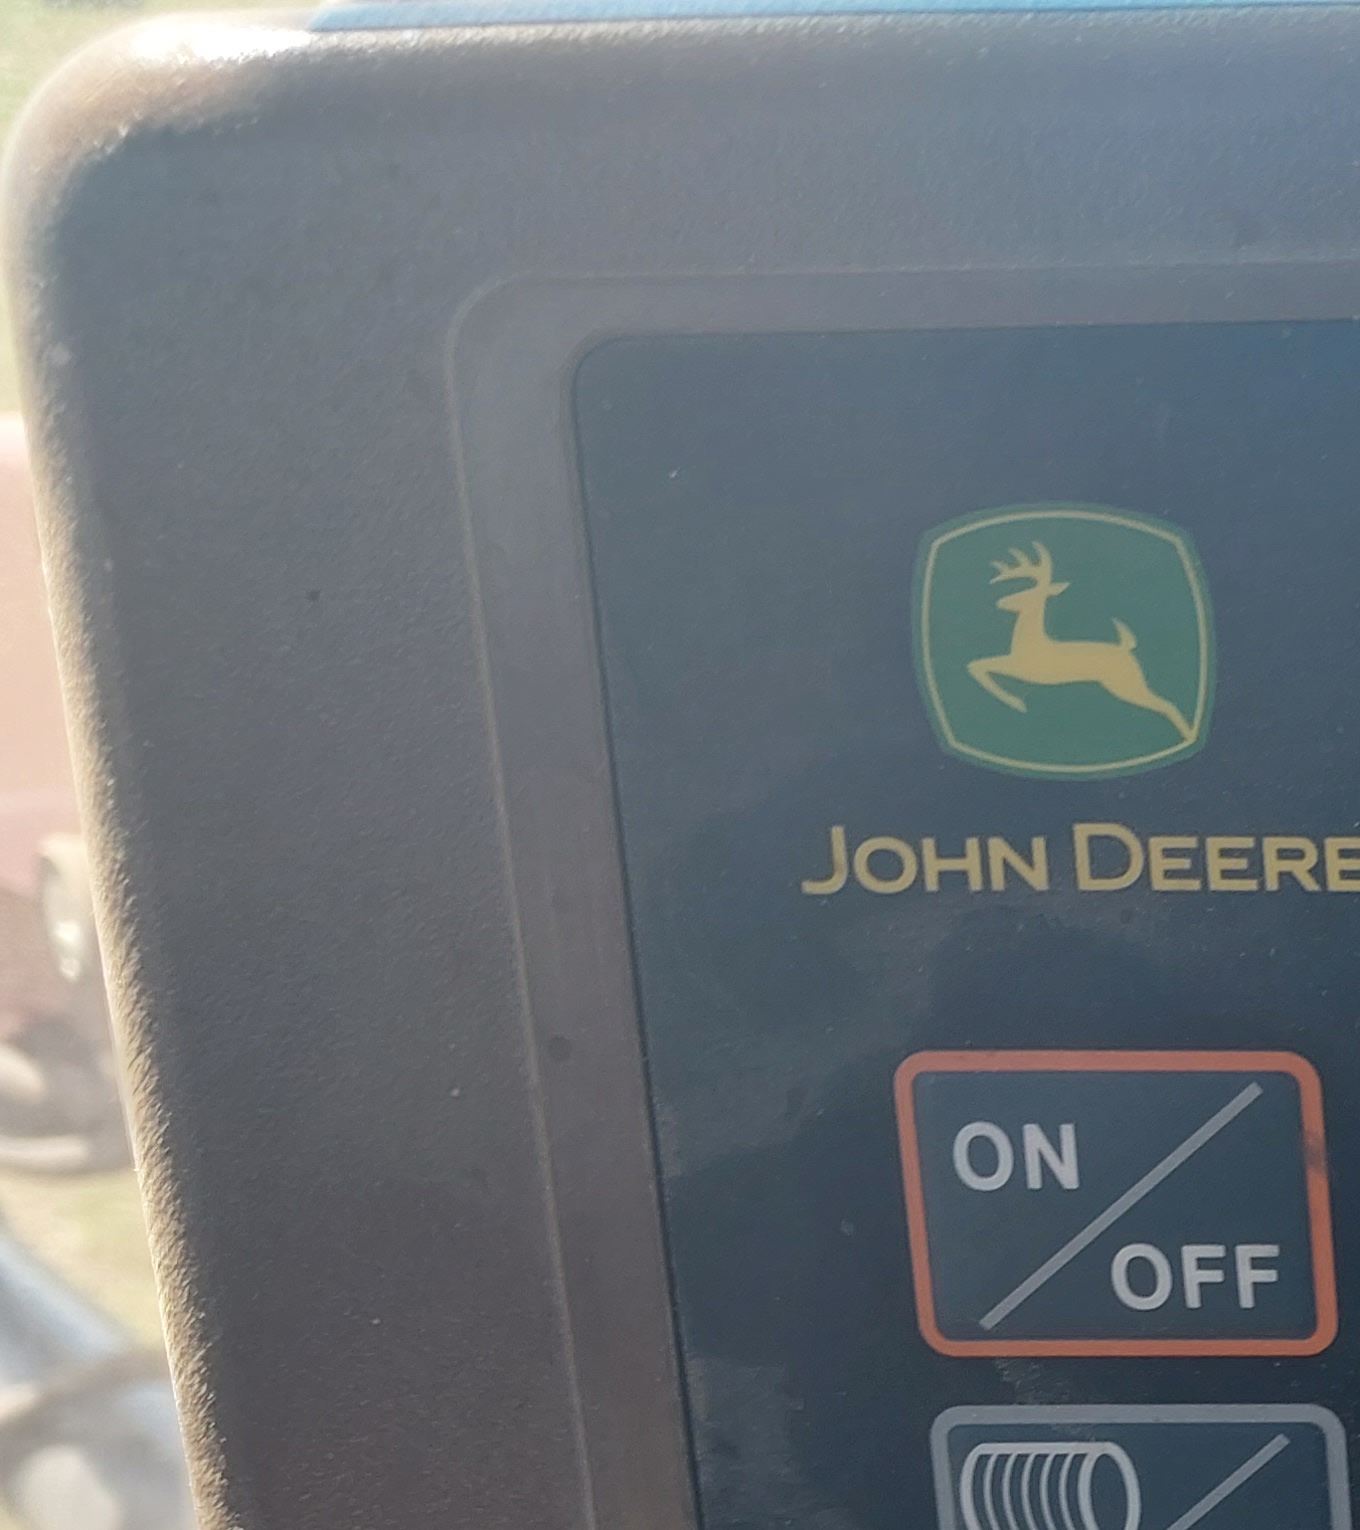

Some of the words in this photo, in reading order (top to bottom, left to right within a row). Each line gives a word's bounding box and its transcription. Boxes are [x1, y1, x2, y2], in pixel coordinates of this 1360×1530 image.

[801, 825, 1050, 895] JOHN
[951, 1120, 1080, 1192] ON
[1110, 1242, 1281, 1312] OFF
